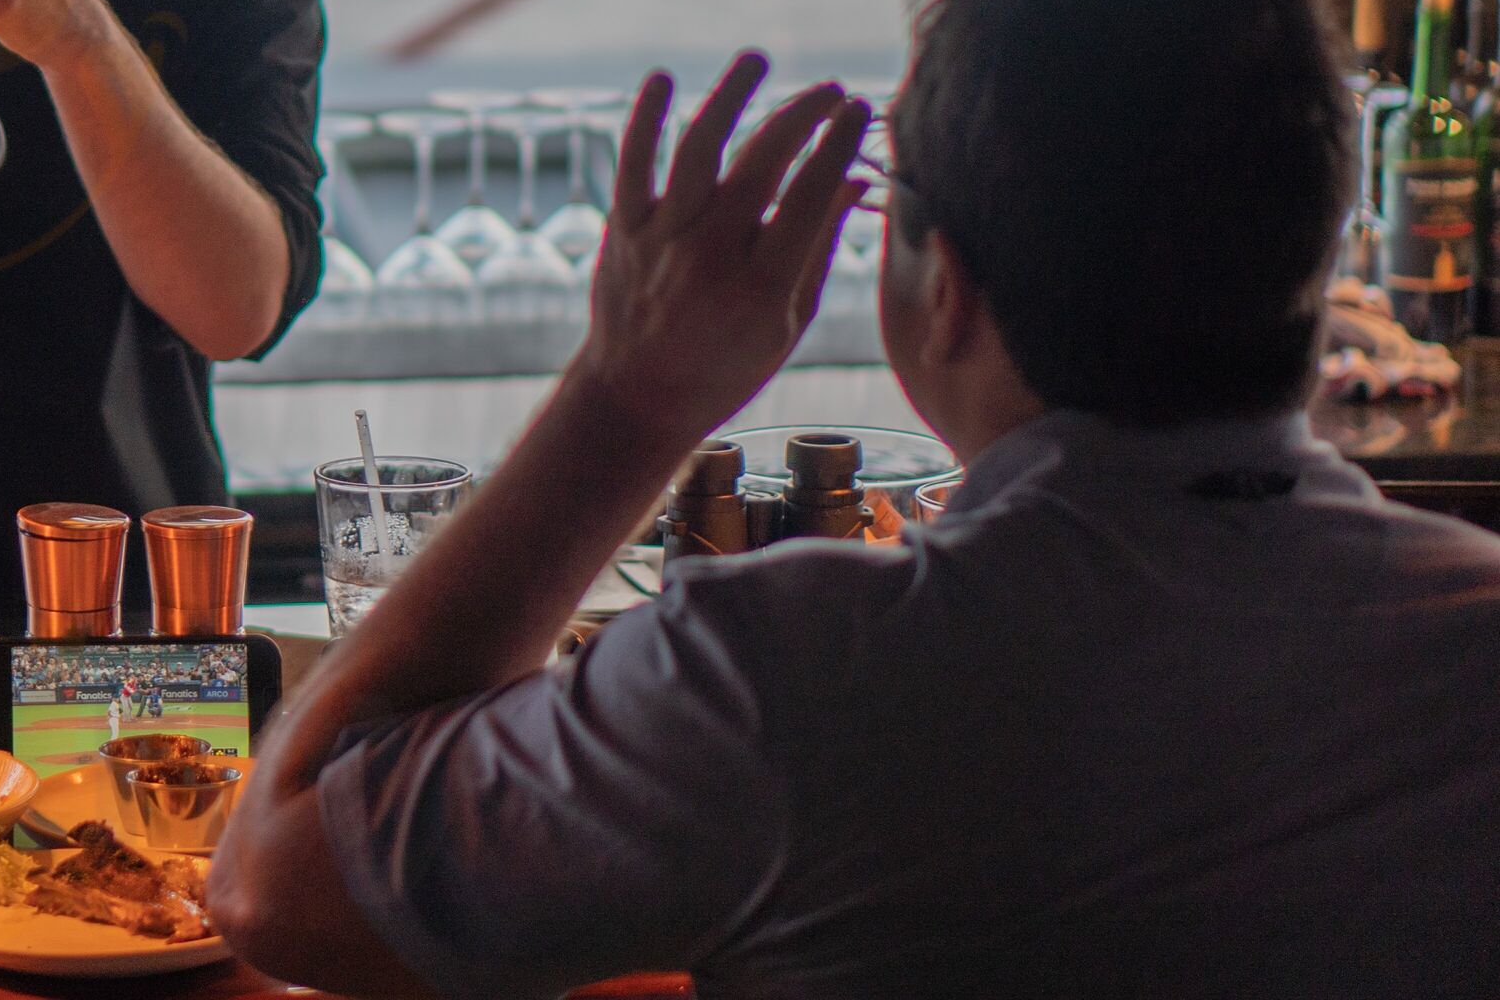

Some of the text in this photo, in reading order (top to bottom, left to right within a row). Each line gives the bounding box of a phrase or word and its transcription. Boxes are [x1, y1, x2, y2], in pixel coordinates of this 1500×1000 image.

[76, 690, 112, 700] Fanatics
[161, 688, 198, 698] Fanatics
[206, 690, 228, 698] ARCO
